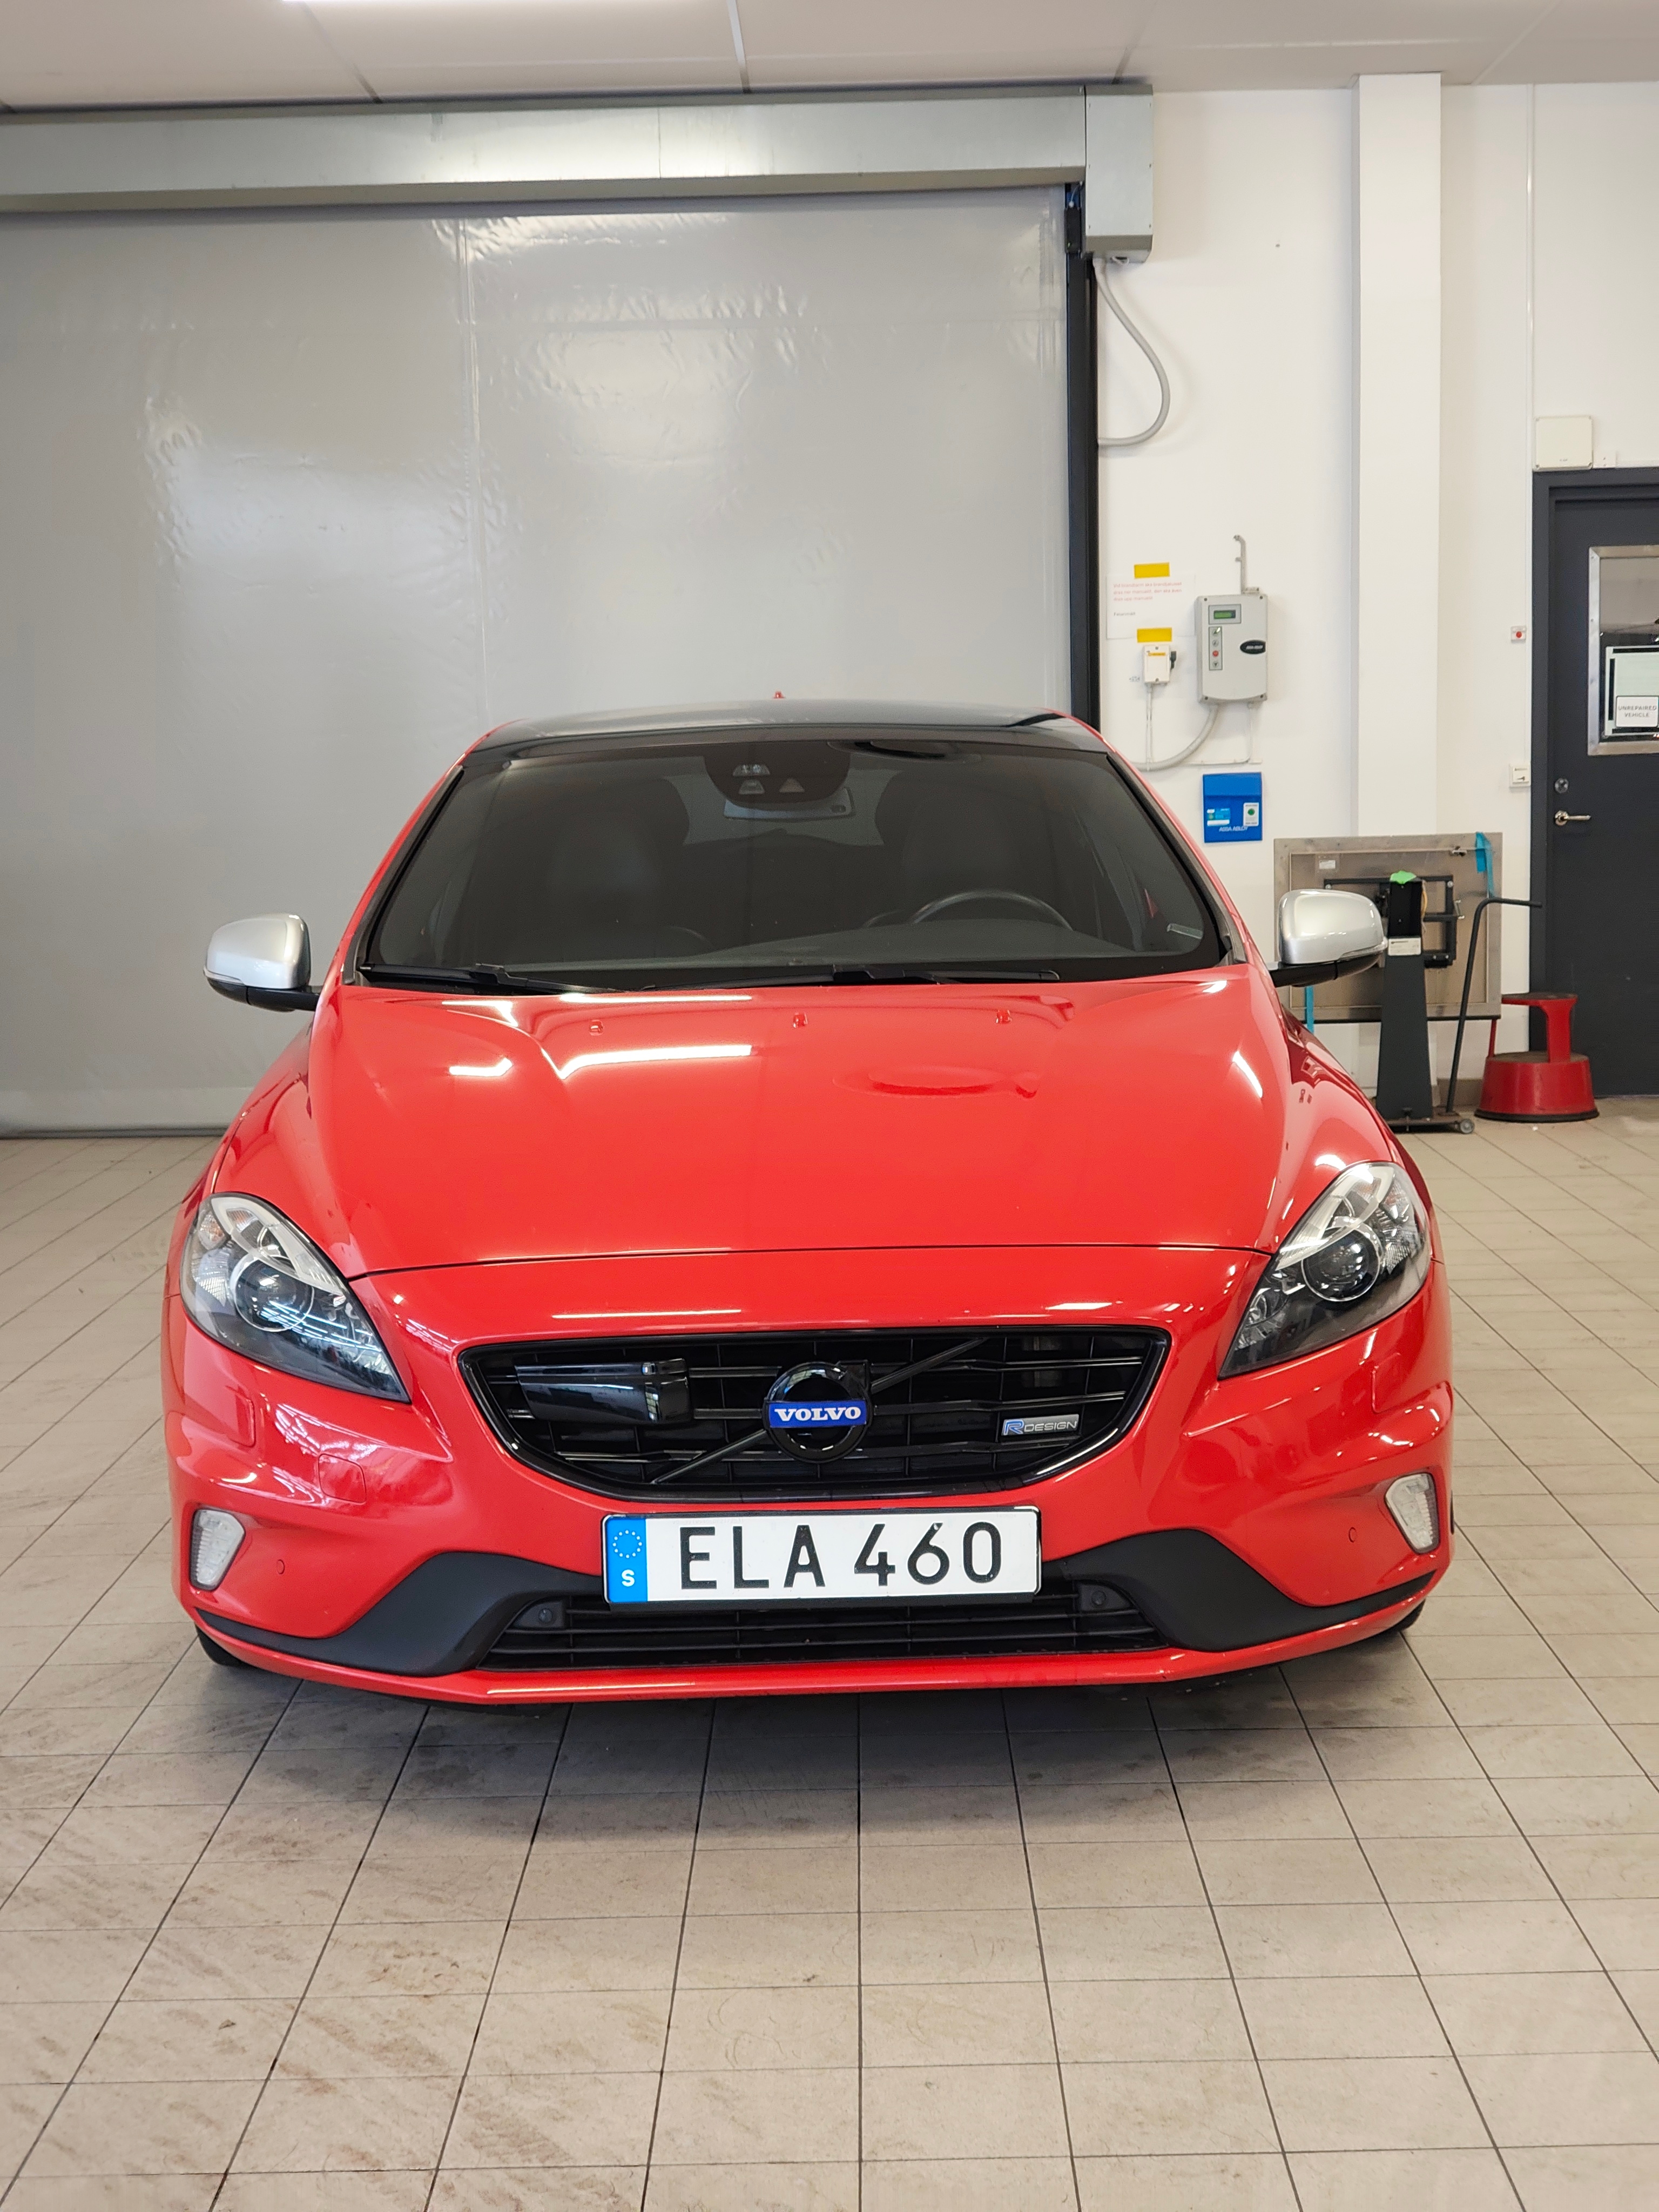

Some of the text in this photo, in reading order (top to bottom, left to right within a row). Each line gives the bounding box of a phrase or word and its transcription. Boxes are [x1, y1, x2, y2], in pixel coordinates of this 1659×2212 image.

[774, 1406, 861, 1421] VOLVO
[679, 1521, 1001, 1590] ELA 460
[621, 1569, 635, 1587] S
